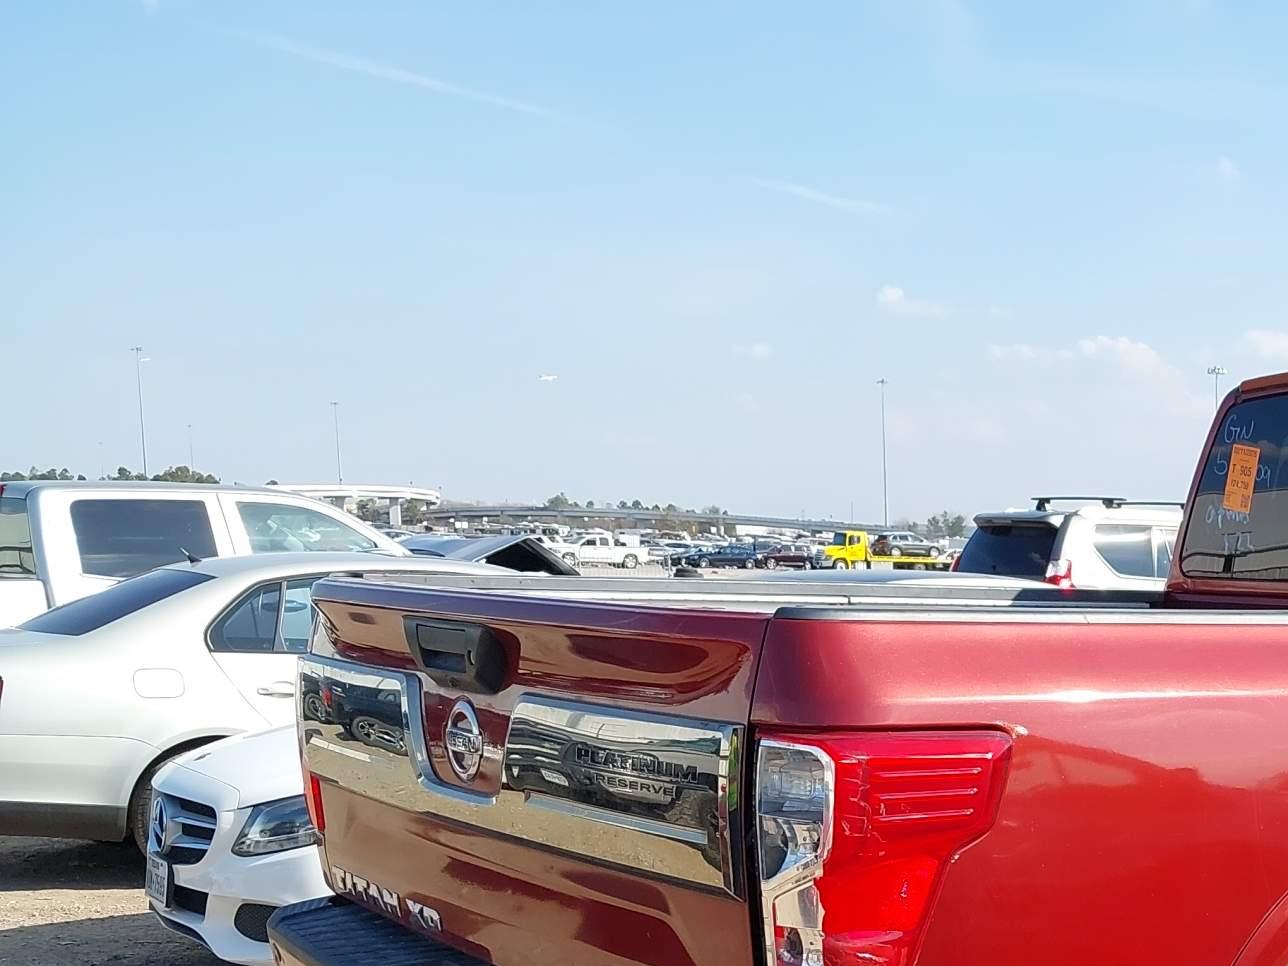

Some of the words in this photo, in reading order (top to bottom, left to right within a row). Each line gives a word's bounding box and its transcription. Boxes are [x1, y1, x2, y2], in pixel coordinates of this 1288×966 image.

[575, 744, 699, 785] PLATINUM
[595, 774, 679, 797] RESERVE
[332, 865, 401, 918] TITAN
[405, 898, 442, 932] XD
